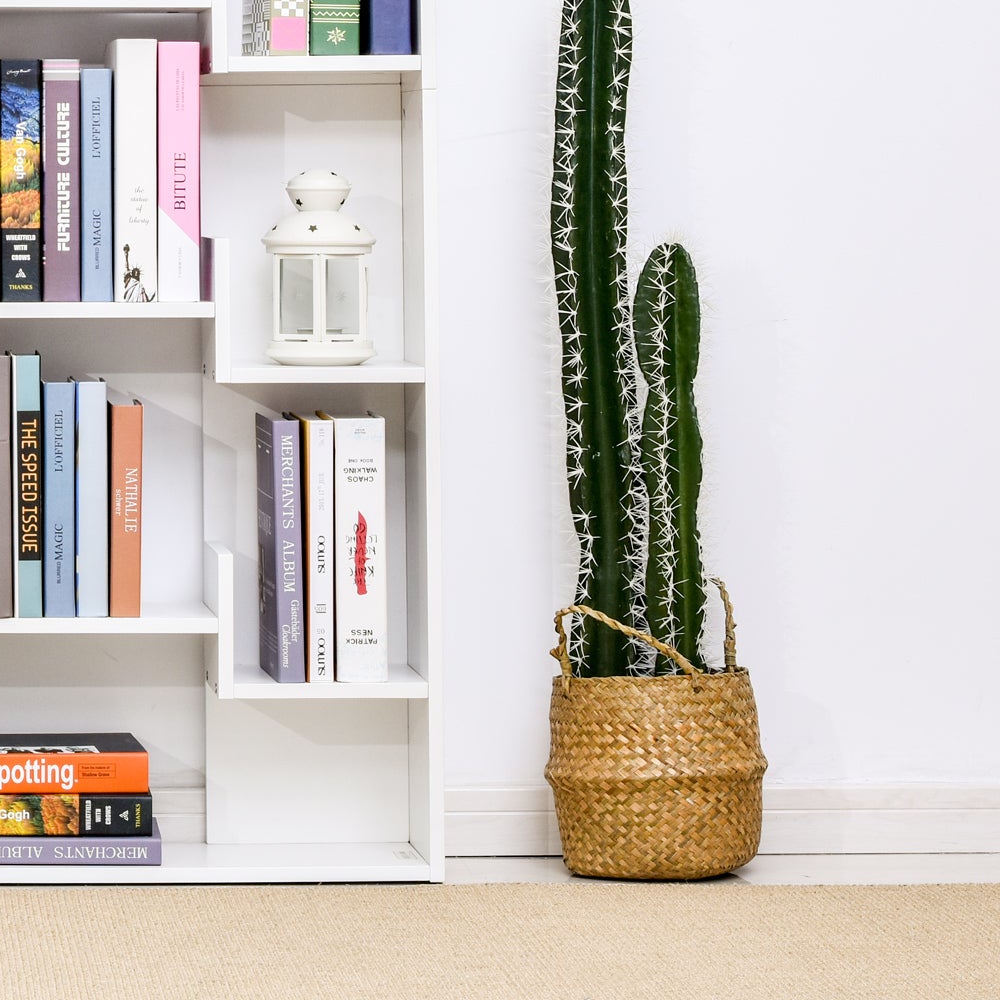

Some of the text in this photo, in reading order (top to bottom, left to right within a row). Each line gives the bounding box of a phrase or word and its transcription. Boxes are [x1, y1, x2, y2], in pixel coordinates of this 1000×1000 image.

[14, 121, 26, 180] Van Gogh
[92, 96, 101, 159] L'OFFICIEL
[57, 102, 70, 252] FURNITURE CULTURE
[173, 152, 187, 211] BITUTE
[92, 209, 102, 246] MAGIC
[54, 409, 64, 473] L'OFFICIEL
[20, 419, 38, 553] THE SPEED ISSUE
[281, 434, 296, 592] MERCHANTS ALBUM
[55, 523, 64, 561] MAGIC
[281, 624, 290, 668] Cloakrooms
[54, 846, 148, 859] MERCHANTS
